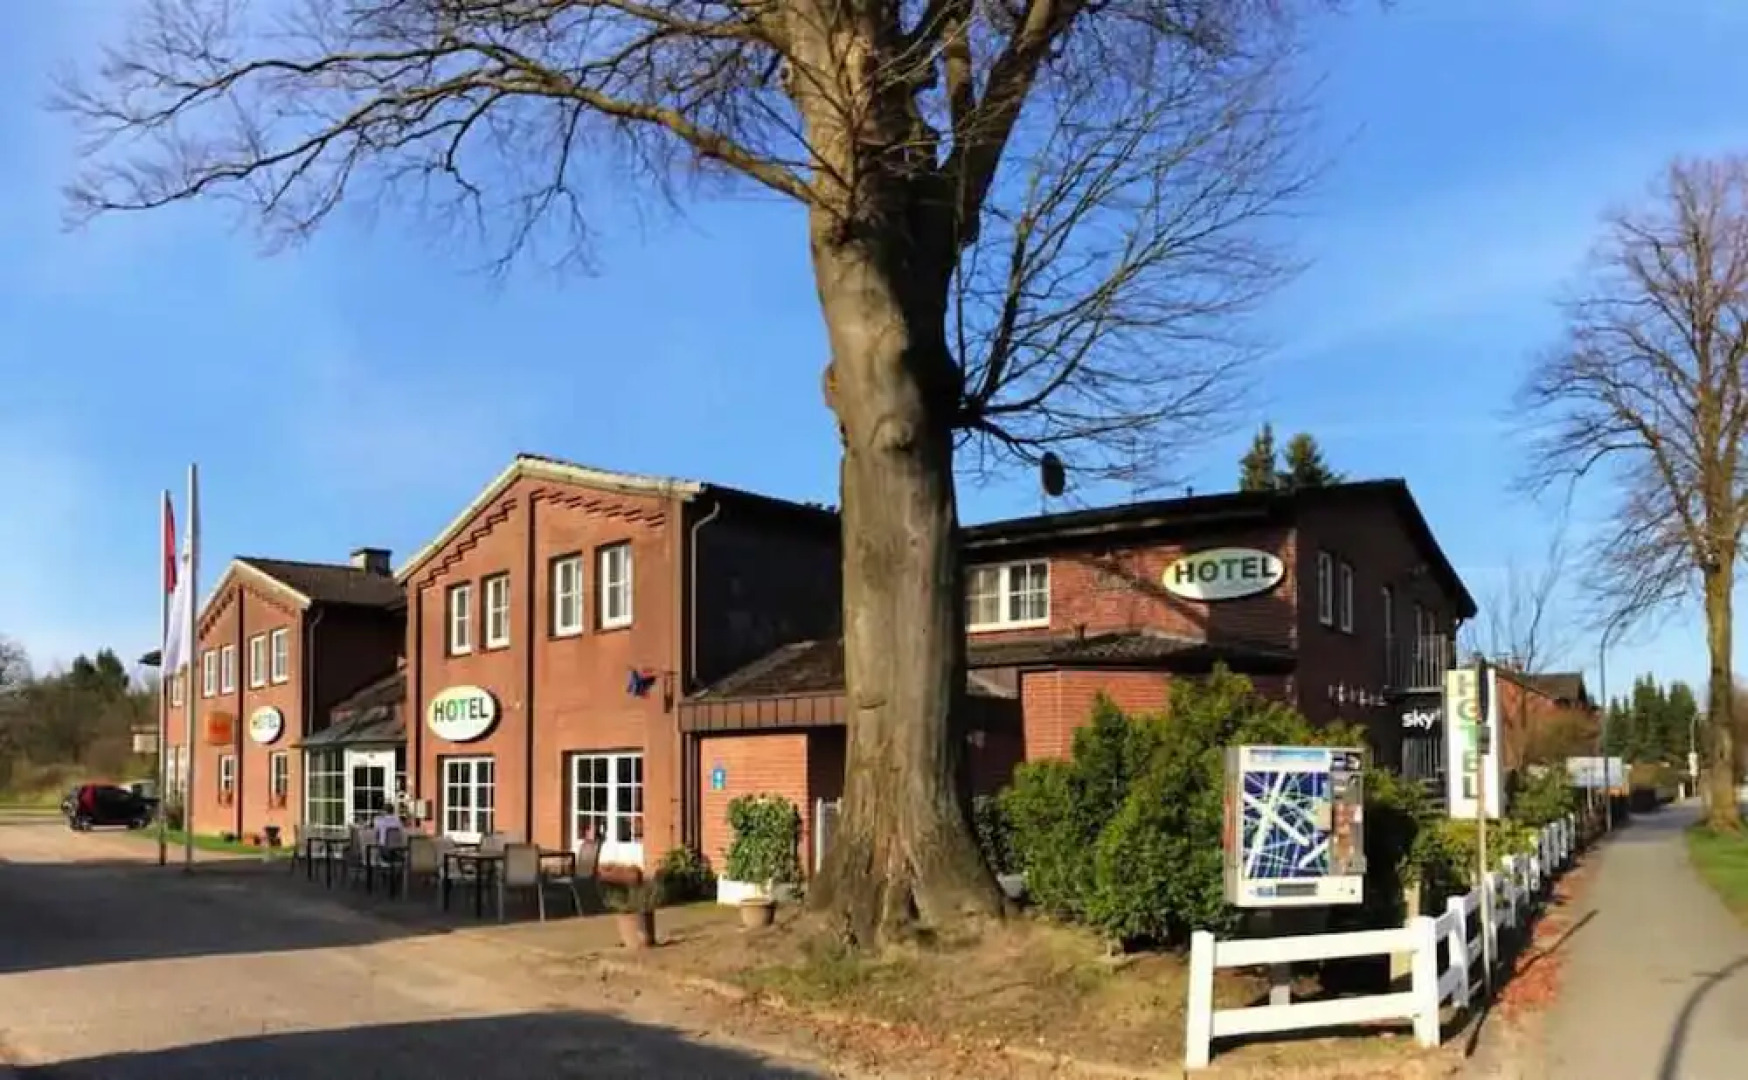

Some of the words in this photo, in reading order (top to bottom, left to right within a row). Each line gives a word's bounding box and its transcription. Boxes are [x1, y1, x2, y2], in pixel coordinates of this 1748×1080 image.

[1175, 557, 1278, 583] HOTEL
[434, 697, 489, 722] HOTEL
[1402, 708, 1435, 732] sky
